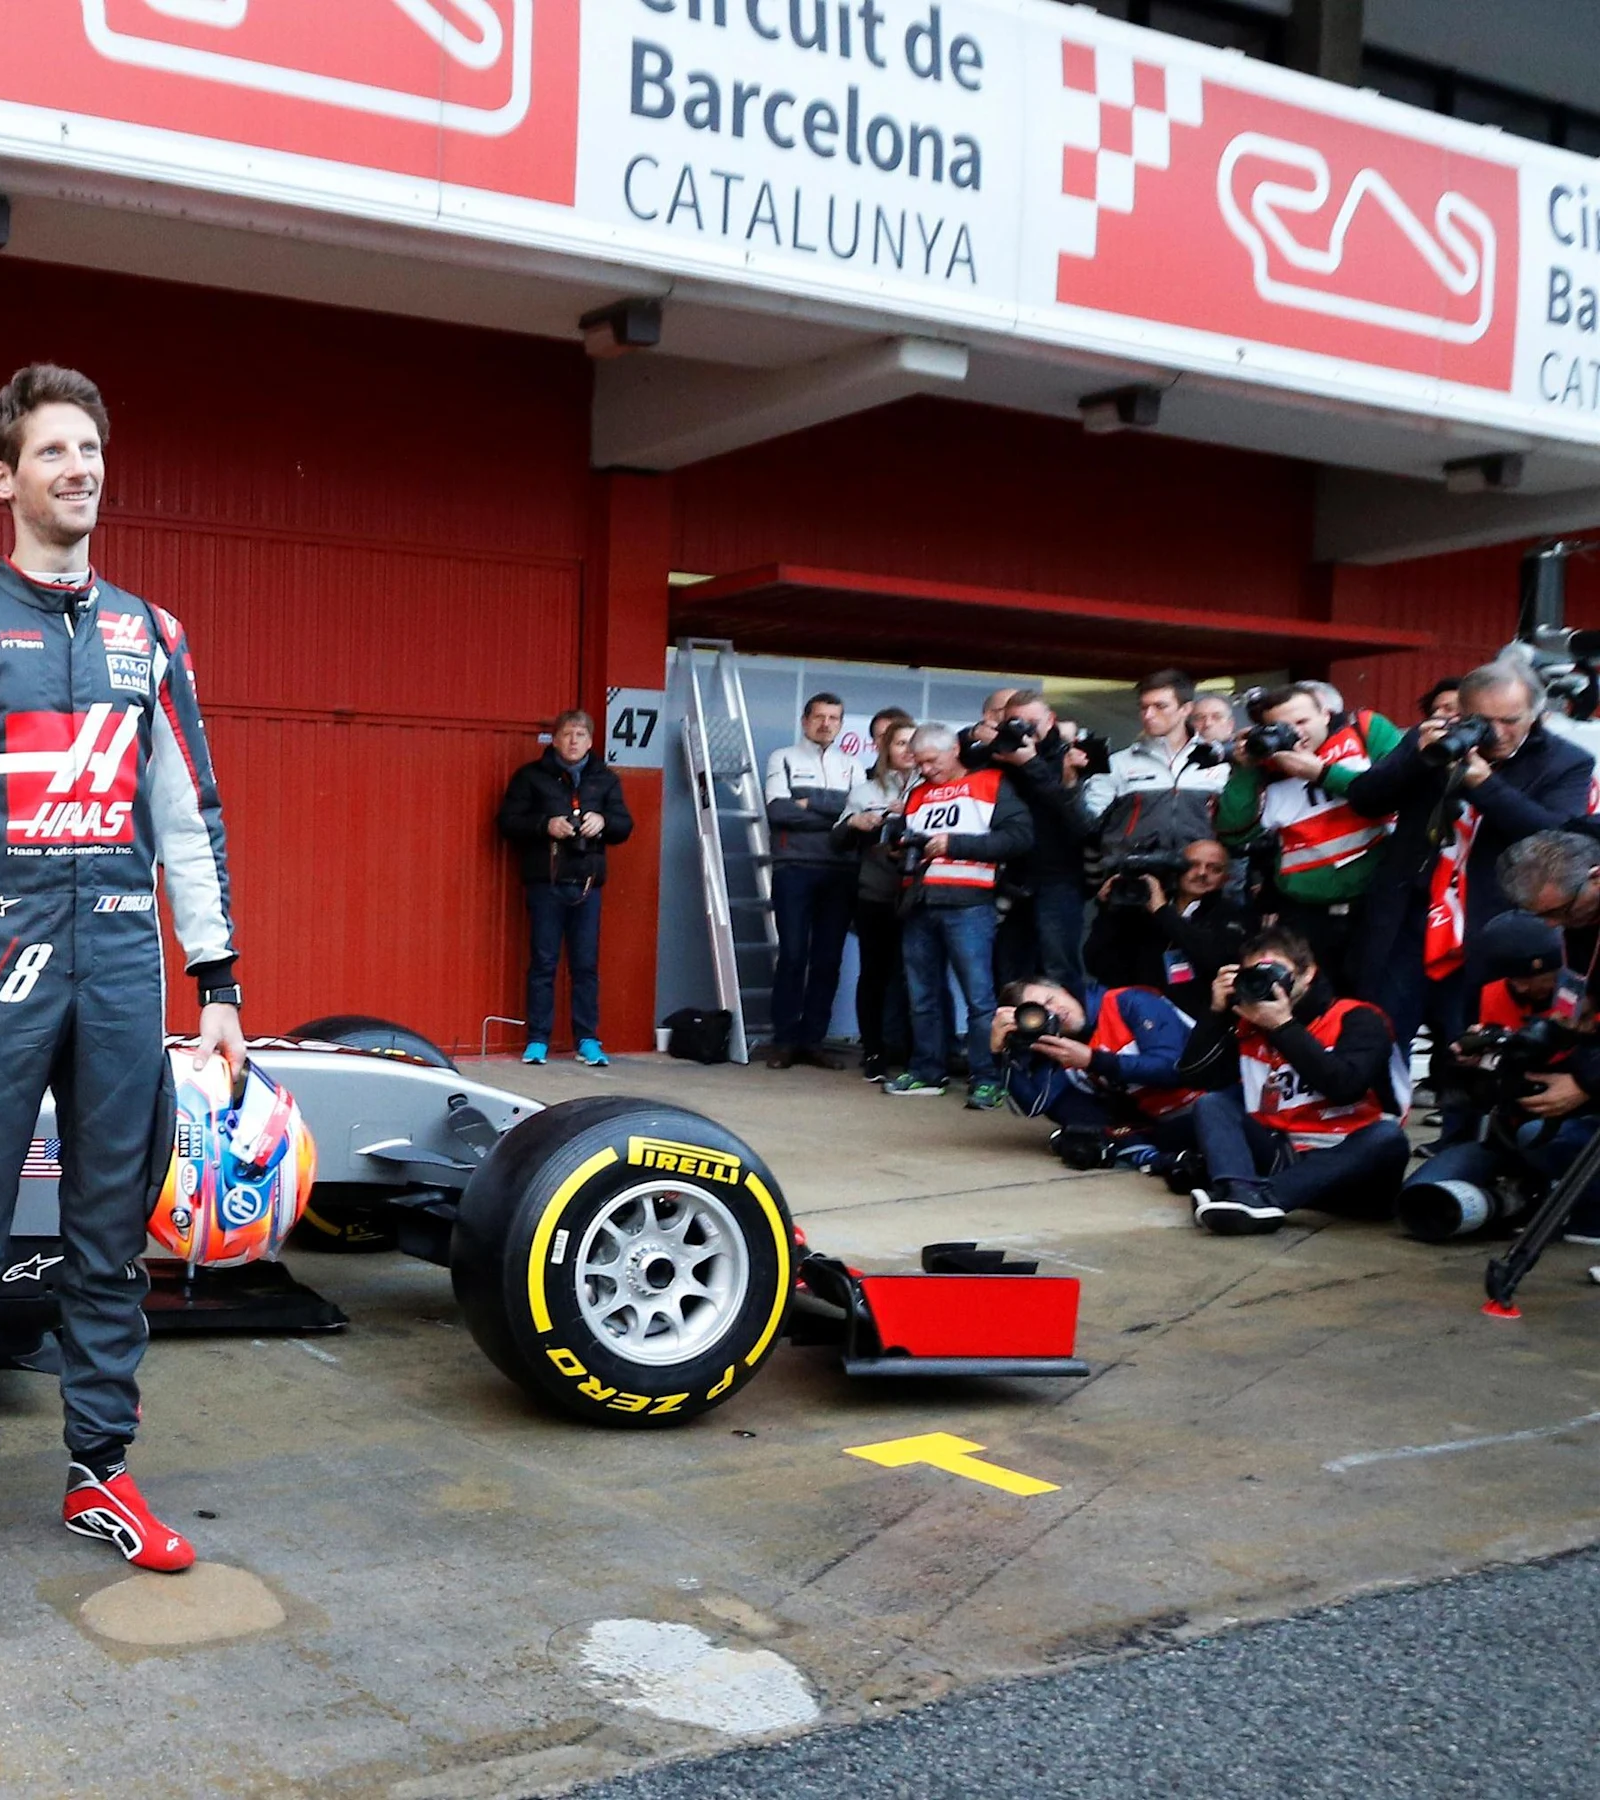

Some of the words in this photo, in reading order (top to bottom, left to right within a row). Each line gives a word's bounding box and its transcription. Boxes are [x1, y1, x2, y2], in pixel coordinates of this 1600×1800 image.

[903, 4, 984, 92] de
[630, 36, 983, 191] Barcelona
[623, 152, 978, 285] CATALUNYA
[111, 659, 147, 672] SAXO
[612, 707, 659, 748] 47
[6, 801, 133, 838] HAAS
[923, 803, 960, 830] 120
[6, 846, 43, 856] Haas
[179, 1125, 190, 1157] BANK
[191, 1125, 203, 1158] SAXO
[627, 1135, 742, 1185] PIRELLI
[546, 1347, 691, 1415] ZERO
[706, 1364, 735, 1400] P
